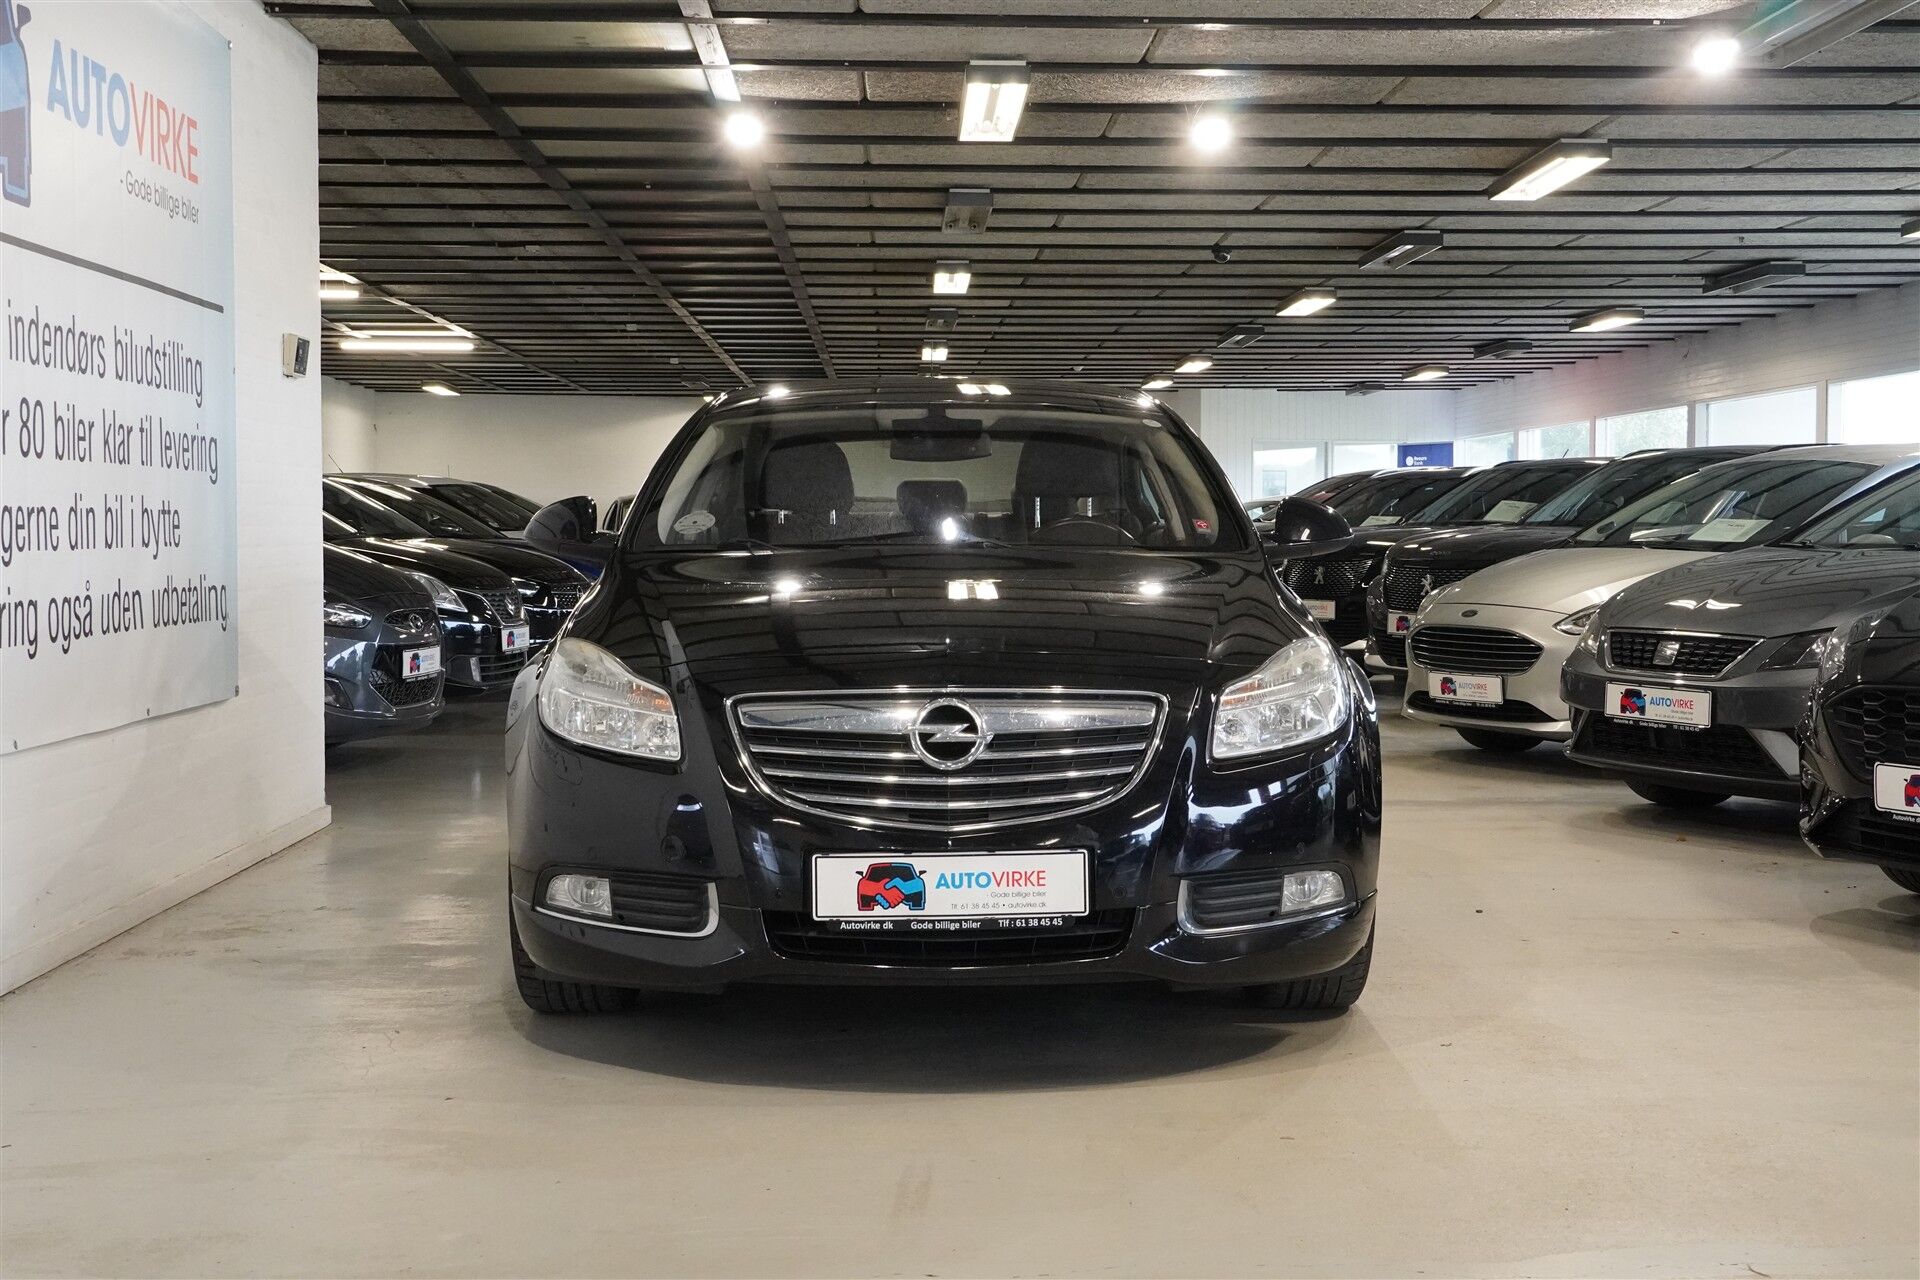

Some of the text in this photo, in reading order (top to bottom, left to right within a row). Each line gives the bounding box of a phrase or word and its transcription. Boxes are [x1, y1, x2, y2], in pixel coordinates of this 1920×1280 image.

[47, 39, 199, 185] AUTOVIRKE
[126, 170, 152, 203] Gode
[154, 182, 180, 219] billige
[181, 195, 200, 224] biler
[7, 299, 203, 408] indendørs biludstilling
[19, 397, 45, 461] 80
[53, 401, 95, 463] biler
[103, 409, 134, 466] klar
[139, 415, 153, 468] til
[160, 417, 219, 486] levering
[1, 493, 182, 568] gerne din bil i bytte
[48, 580, 93, 656] også
[101, 578, 145, 636] uden
[152, 574, 228, 632] udbetaling
[1458, 682, 1488, 691] AUTOVIRKE
[1649, 696, 1694, 710] AUTOVIRKE
[1892, 814, 1915, 823] Autovirke
[935, 870, 1046, 889] AUTOVIRKE
[990, 891, 1010, 899] Gode
[1011, 891, 1031, 899] billige
[840, 921, 894, 930] Autovirke dk
[910, 920, 981, 931] Gode billige biler
[1015, 918, 1026, 927] 61
[1028, 918, 1039, 927] 38
[1040, 918, 1050, 926] 45
[1052, 917, 1063, 926] 45
